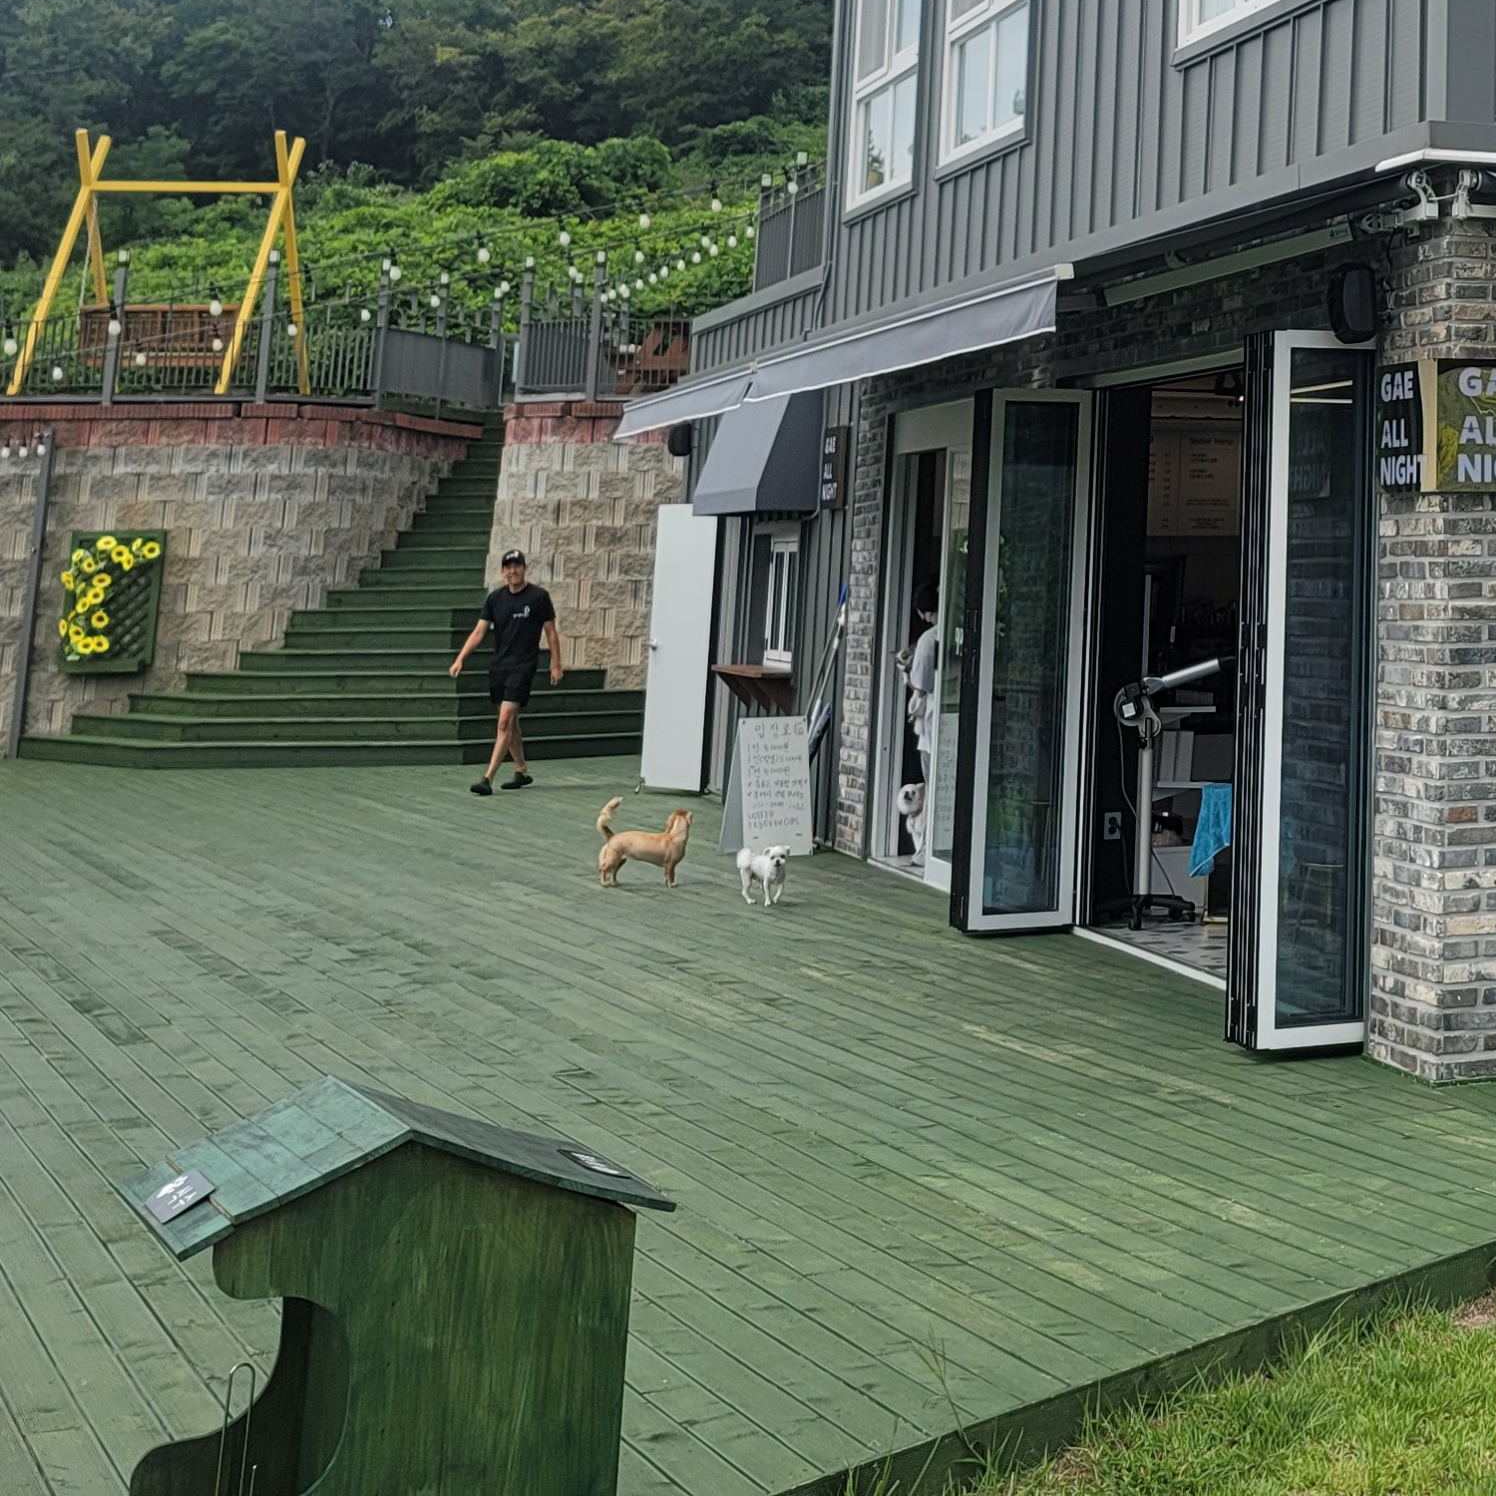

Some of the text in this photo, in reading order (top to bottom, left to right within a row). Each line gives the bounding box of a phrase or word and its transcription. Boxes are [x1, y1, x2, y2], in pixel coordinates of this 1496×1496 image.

[1380, 370, 1414, 402] GAE
[1380, 418, 1408, 448] ALL
[1380, 454, 1427, 486] NIGHT
[822, 482, 837, 500] NIGHT
